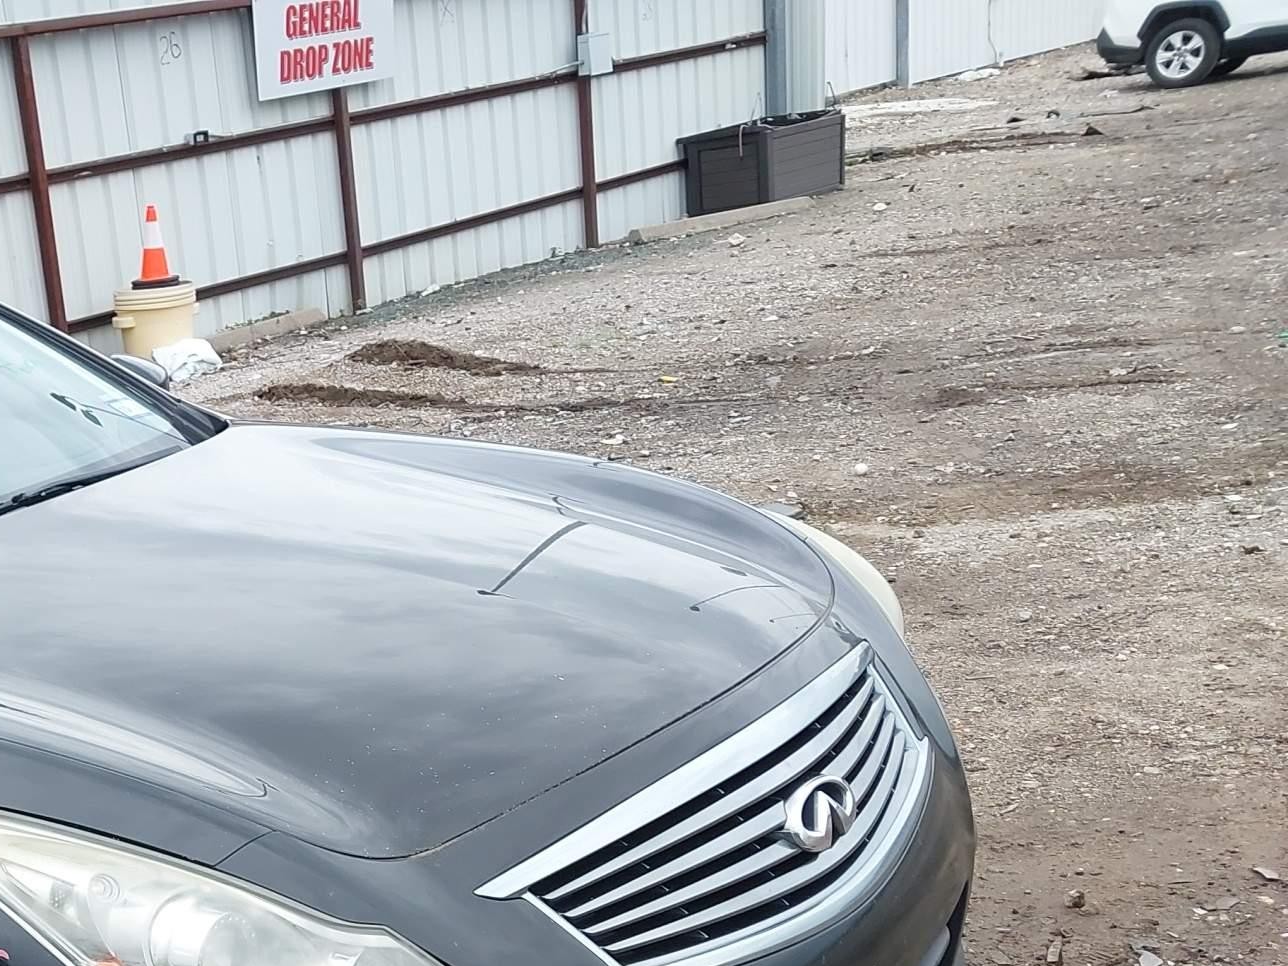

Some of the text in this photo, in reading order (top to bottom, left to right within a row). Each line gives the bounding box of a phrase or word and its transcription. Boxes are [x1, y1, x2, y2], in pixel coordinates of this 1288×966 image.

[285, 0, 361, 40] GENERAL
[159, 31, 182, 65] 26
[279, 37, 374, 84] DROP ZONE
